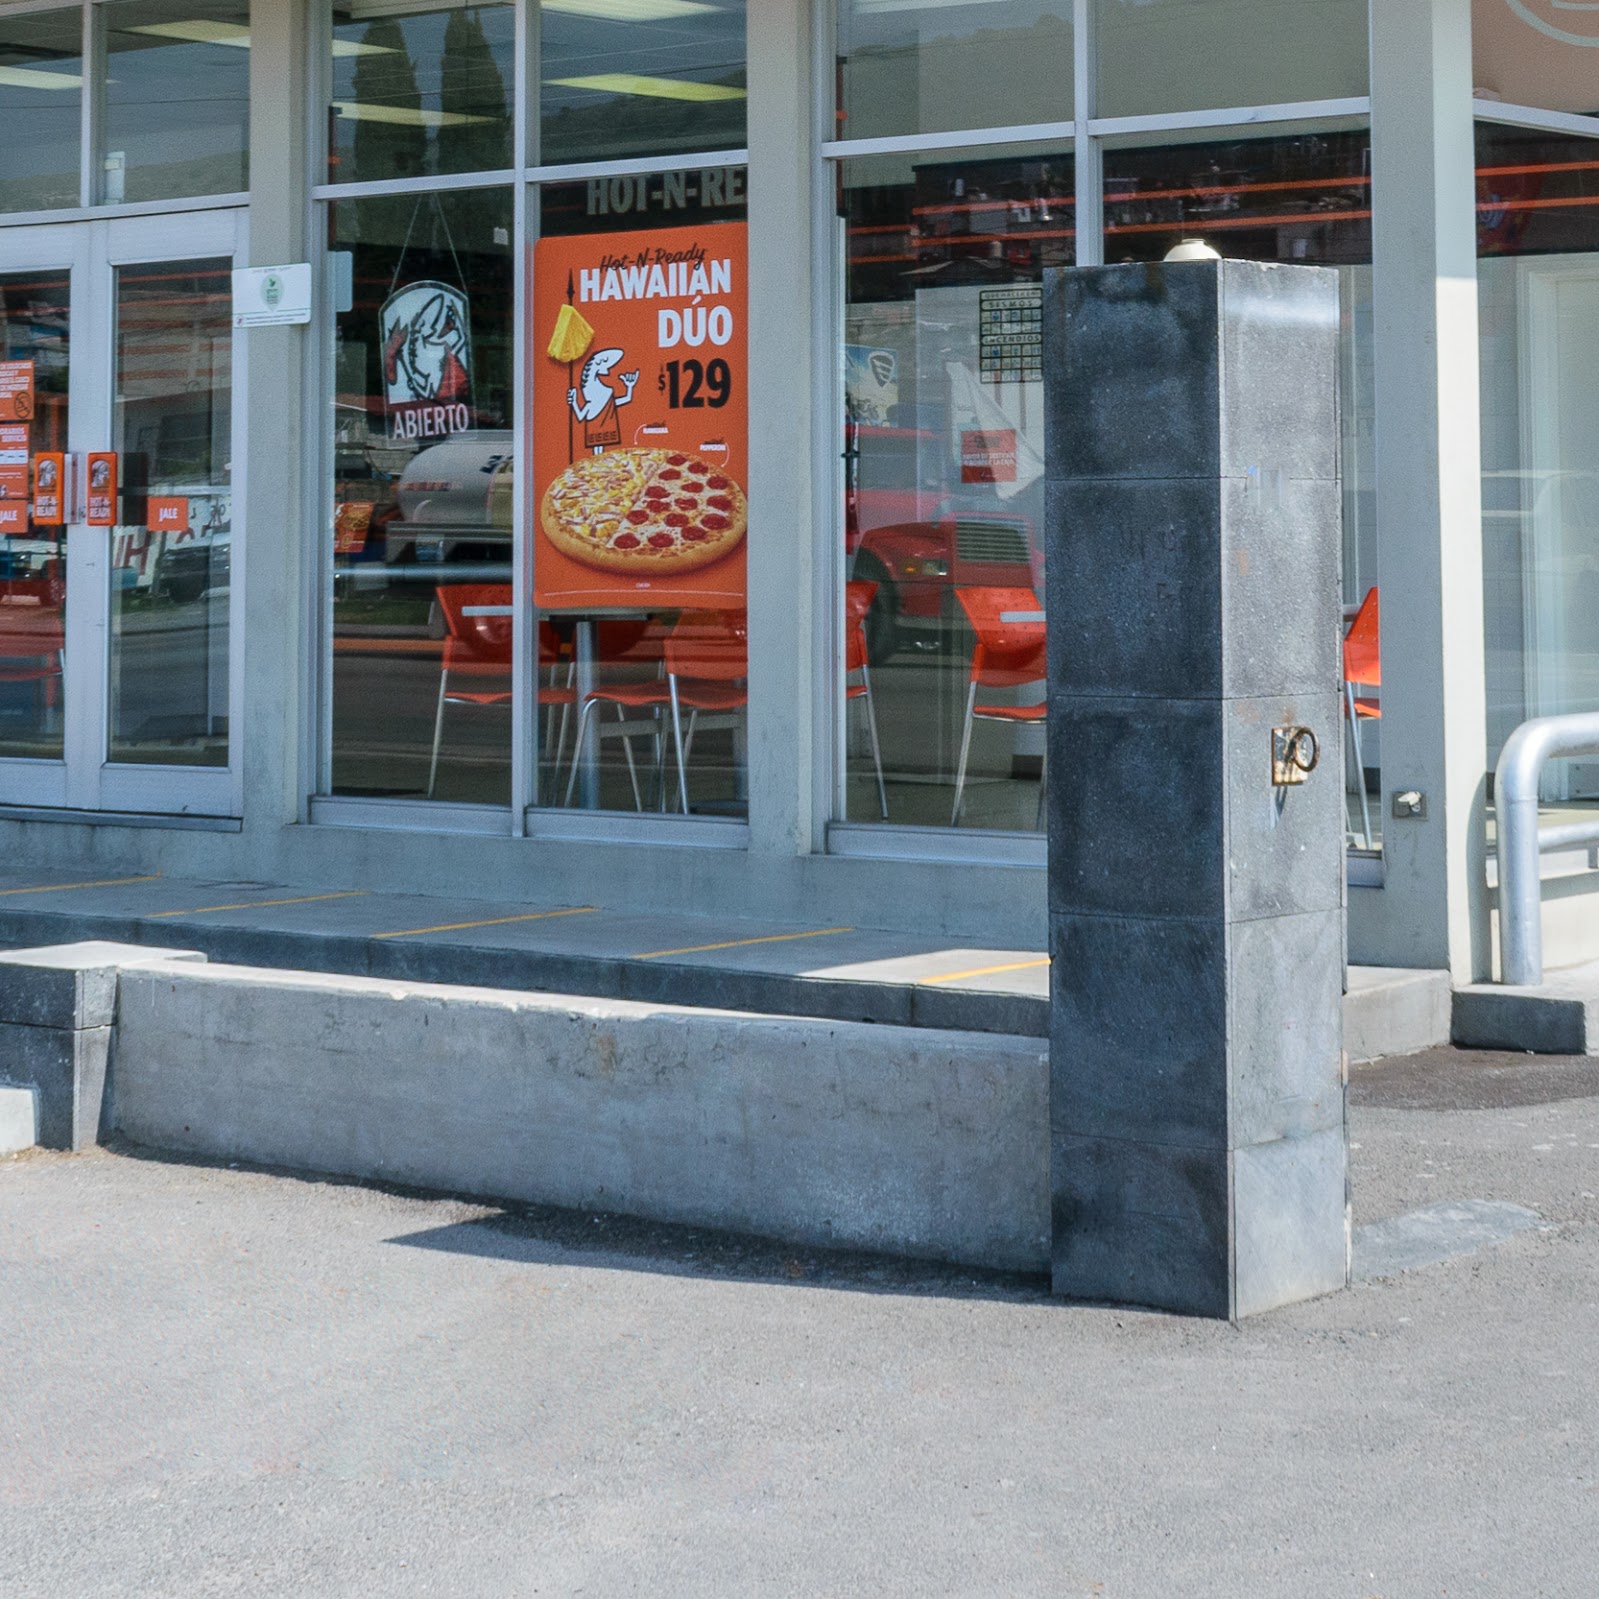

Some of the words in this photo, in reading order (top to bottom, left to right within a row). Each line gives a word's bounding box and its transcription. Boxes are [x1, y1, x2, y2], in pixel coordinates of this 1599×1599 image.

[600, 242, 707, 273] Hot-N-Ready
[579, 258, 732, 302] HAWAIIAN
[657, 295, 733, 349] DÚO
[988, 301, 1033, 309] SISMOS
[658, 358, 731, 409] $129
[393, 403, 470, 441] ABIERTO
[0, 509, 18, 525] JALE
[158, 507, 178, 522] JALE
